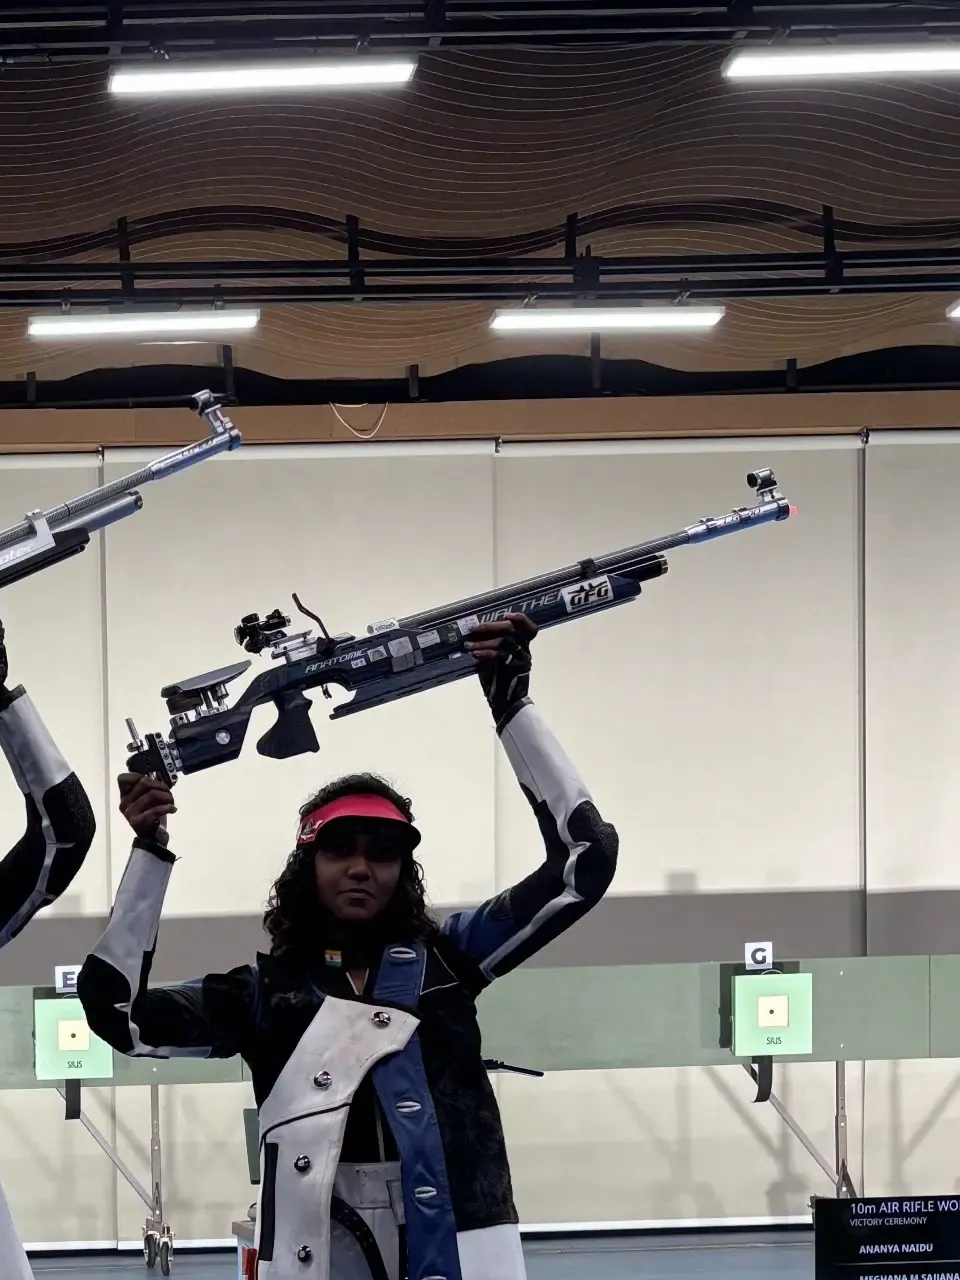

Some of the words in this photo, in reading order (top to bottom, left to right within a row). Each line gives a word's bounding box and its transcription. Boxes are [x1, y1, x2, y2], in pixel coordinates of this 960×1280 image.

[305, 647, 368, 673] ANATOMIC
[750, 947, 767, 965] G
[62, 971, 76, 988] E
[766, 1036, 782, 1045] SIUS
[67, 1060, 83, 1069] SIUS
[850, 1203, 877, 1215] 10m
[879, 1201, 900, 1213] AIR
[903, 1200, 934, 1213] RIFLE
[937, 1199, 960, 1212] WO
[850, 1217, 883, 1227] VICTORY
[884, 1216, 928, 1226] CEREMONY
[859, 1244, 900, 1255] ANANYA
[901, 1243, 934, 1253] NAIDU
